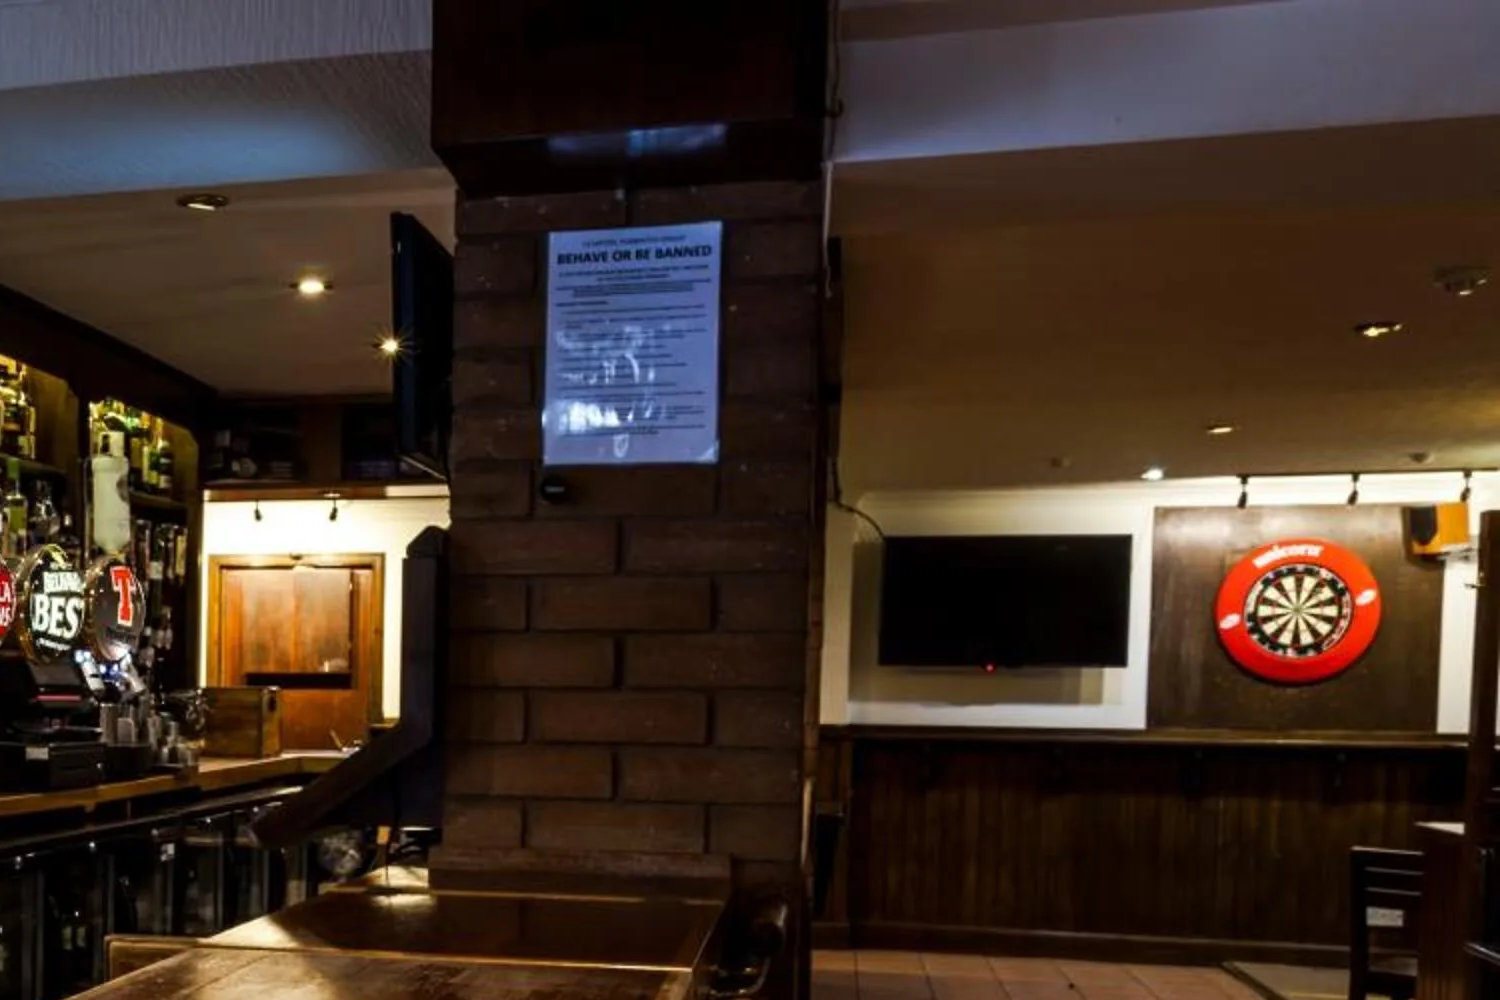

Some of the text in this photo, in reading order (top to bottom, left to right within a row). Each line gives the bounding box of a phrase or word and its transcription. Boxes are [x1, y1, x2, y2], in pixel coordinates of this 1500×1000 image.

[556, 245, 713, 265] BEHAVE OR BE BANNED
[32, 593, 84, 639] BES
